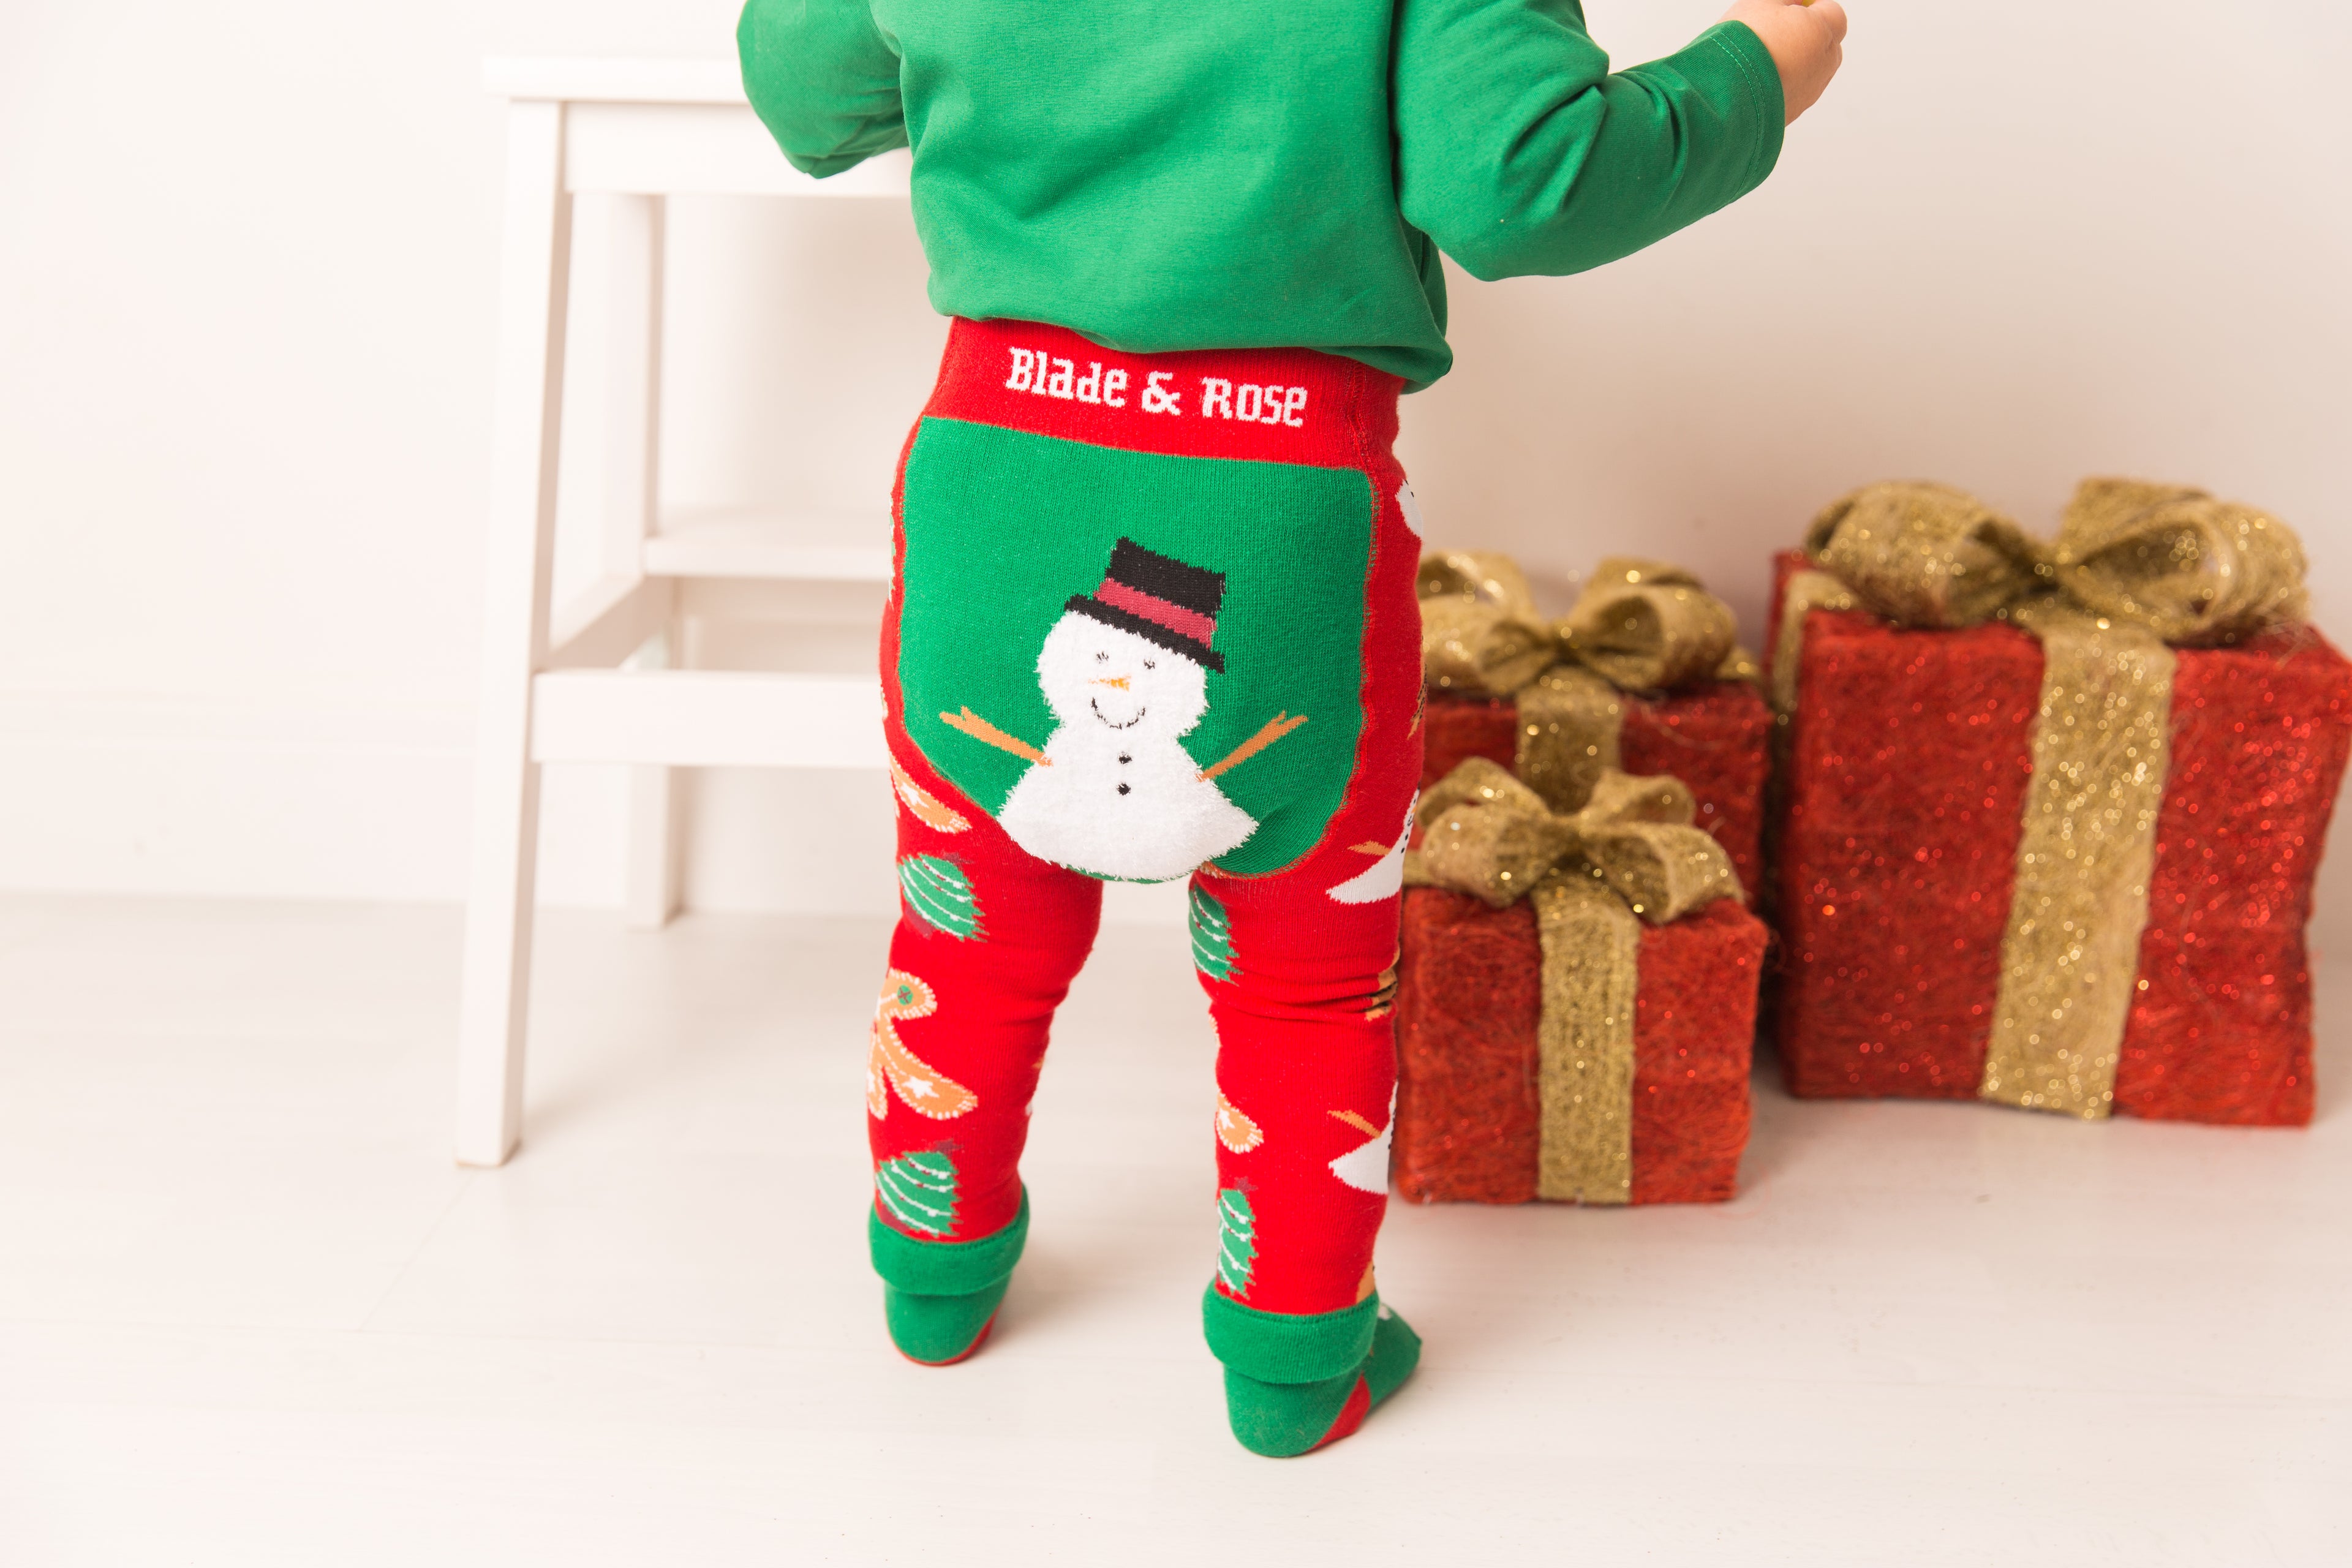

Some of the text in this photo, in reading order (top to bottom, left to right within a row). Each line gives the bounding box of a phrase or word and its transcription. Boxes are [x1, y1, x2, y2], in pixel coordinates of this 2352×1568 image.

[1005, 346, 1308, 428] Blade & Rose
